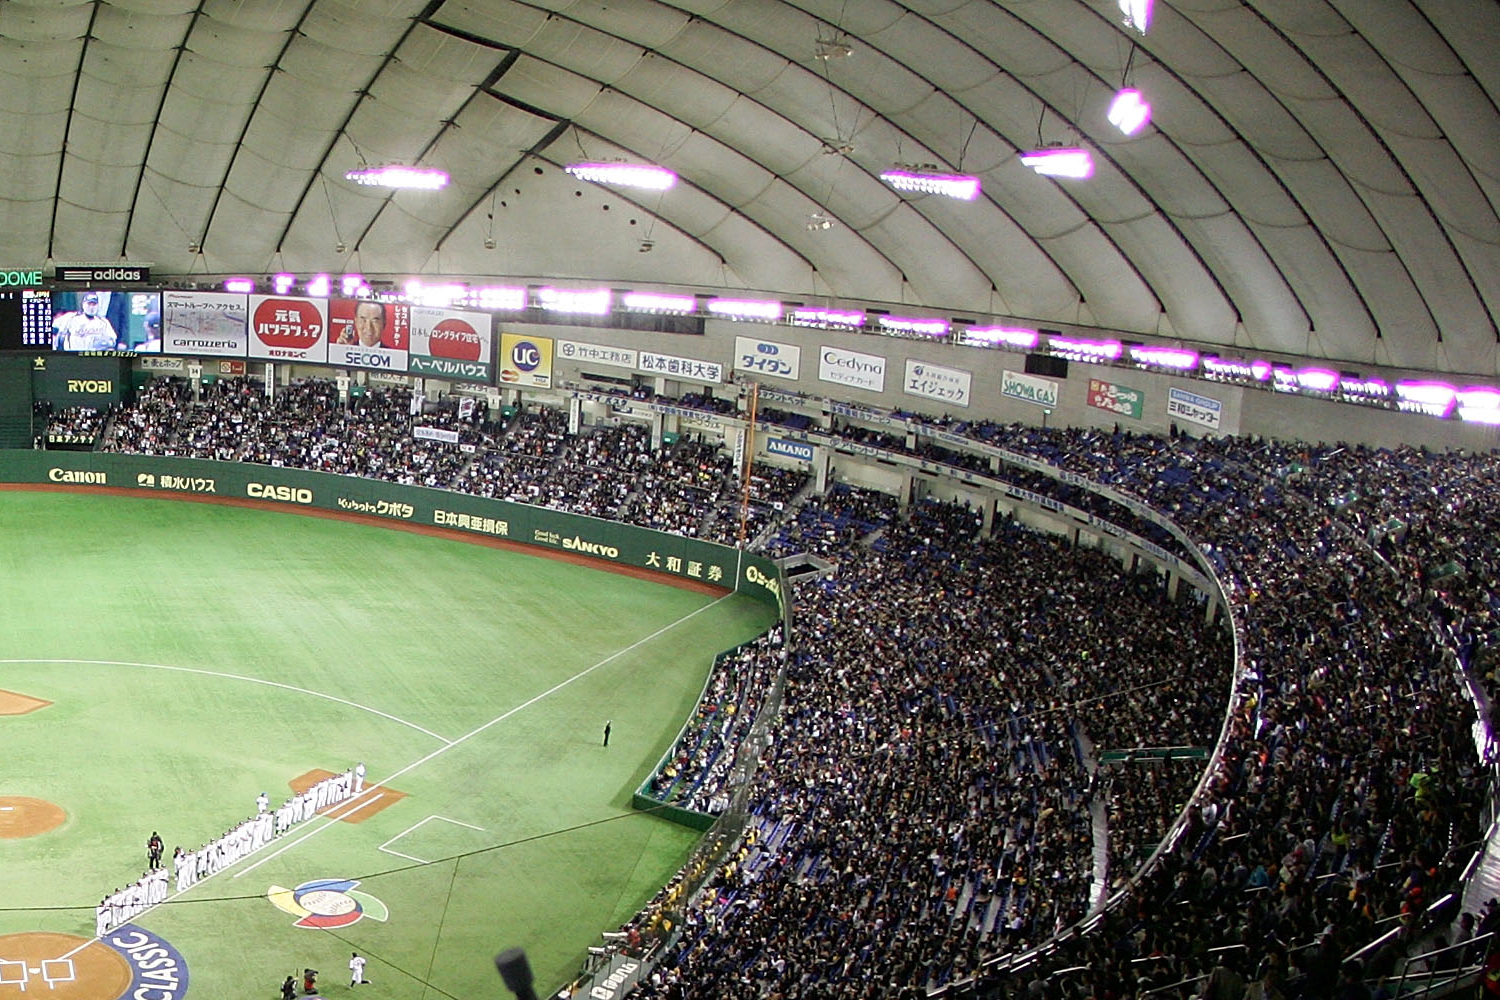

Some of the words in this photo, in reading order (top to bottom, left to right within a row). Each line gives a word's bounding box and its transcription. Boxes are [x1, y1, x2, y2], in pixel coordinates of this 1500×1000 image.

[94, 269, 141, 281] adidas
[275, 310, 301, 322] 元気
[173, 339, 238, 349] carrozzeria
[268, 350, 307, 359] オロナミンC
[346, 352, 391, 367] SECOM
[513, 349, 540, 366] UC
[578, 347, 632, 364] 竹中工務店
[824, 351, 882, 375] Cedyna
[412, 359, 487, 377] ヘーベルハウス
[642, 355, 719, 380] 松本歯科大学
[742, 355, 792, 375] ダイダン
[68, 380, 112, 393] RYOBI
[910, 379, 964, 401] エイジェック
[1003, 380, 1035, 400] SHOWA
[1037, 388, 1056, 404] GAS
[1170, 401, 1219, 422] 三和シャッター
[769, 442, 811, 458] AMANO
[49, 468, 107, 484] Canon
[160, 475, 216, 493] 積水ハウス
[247, 483, 313, 504] CASIO
[377, 500, 414, 518] クボタ
[434, 510, 509, 536] 日本興亜損保
[562, 536, 619, 558] SANKYO
[646, 552, 723, 582] 大和証券
